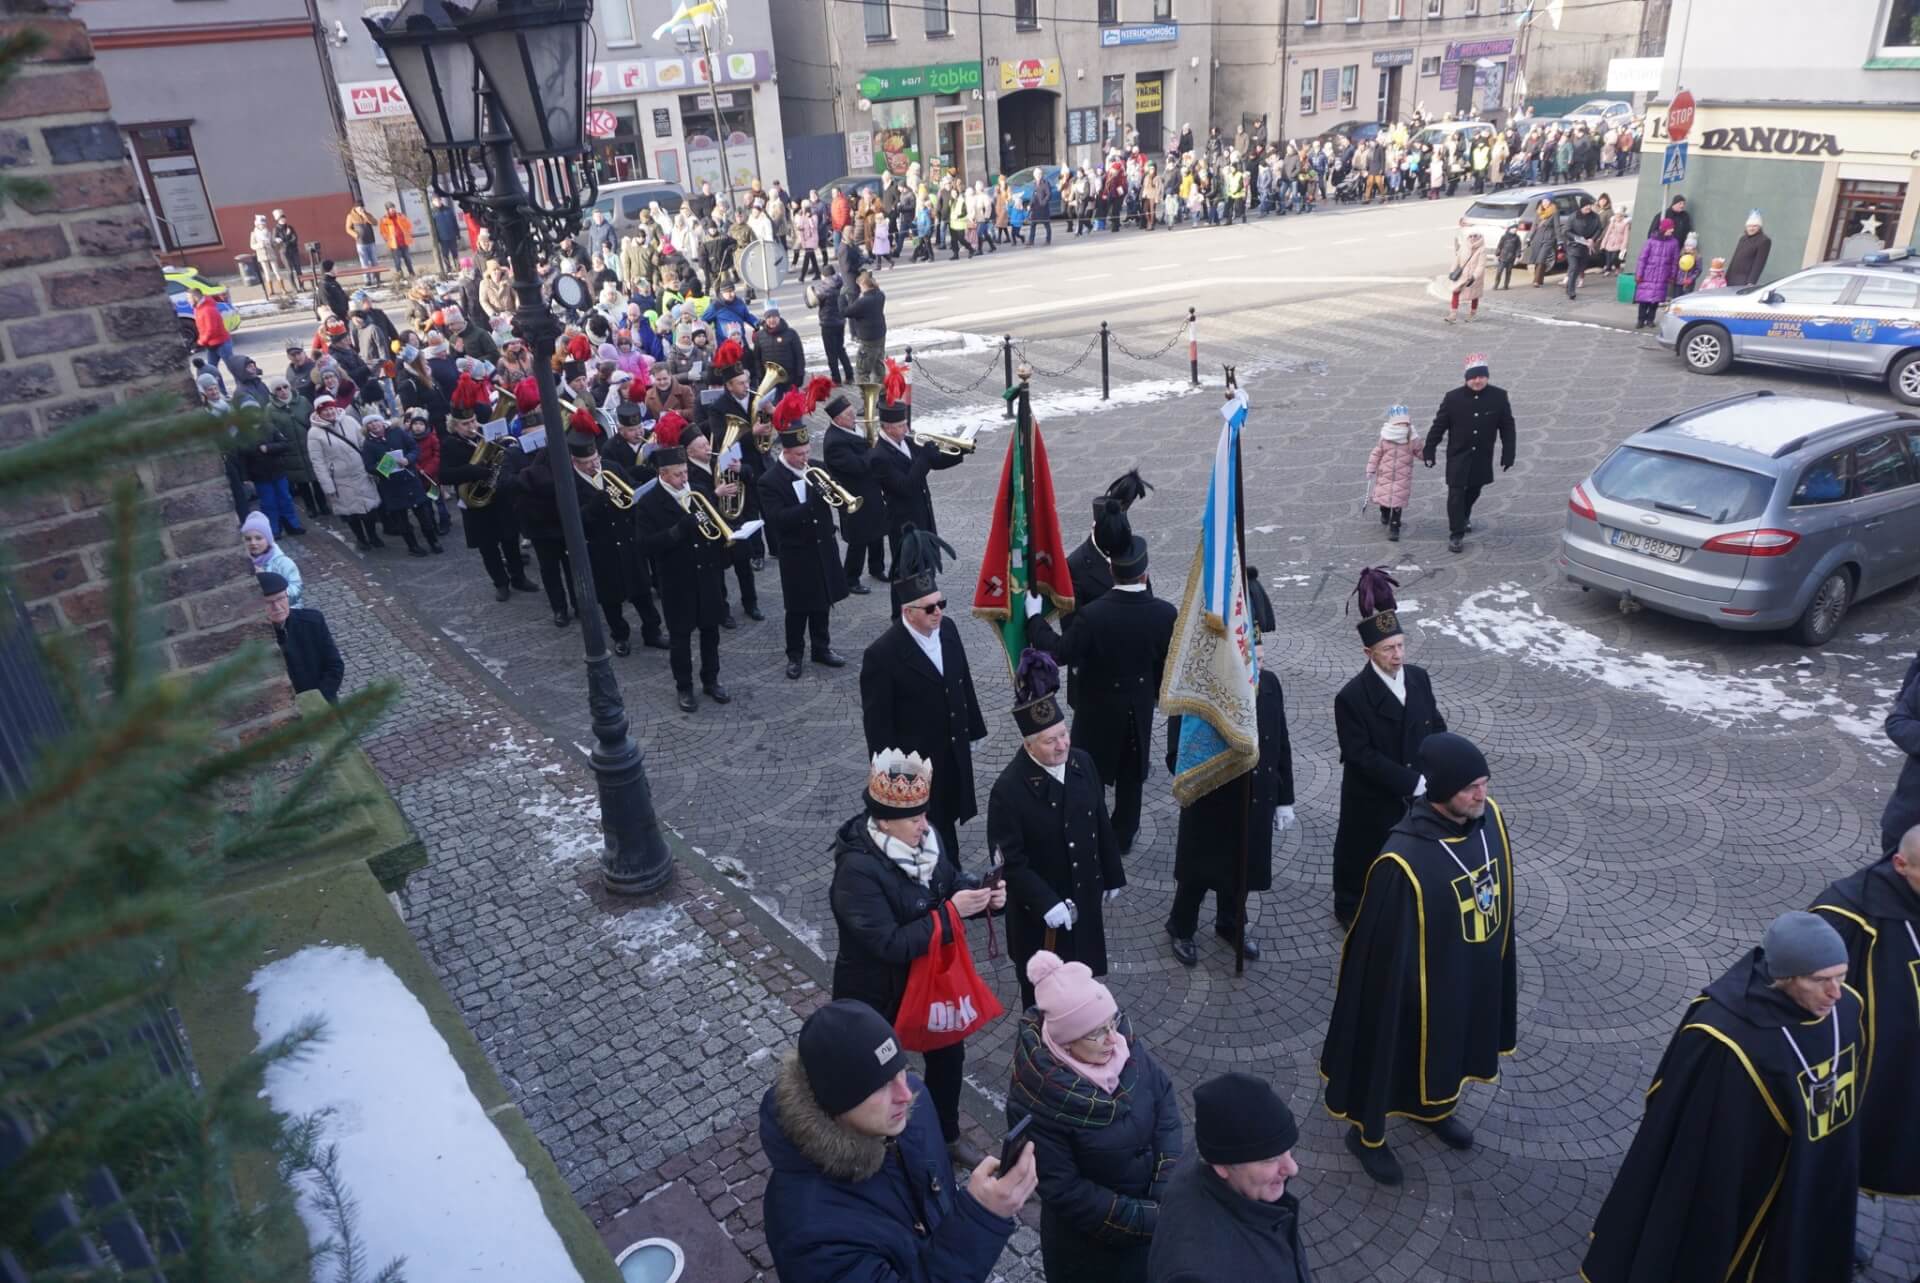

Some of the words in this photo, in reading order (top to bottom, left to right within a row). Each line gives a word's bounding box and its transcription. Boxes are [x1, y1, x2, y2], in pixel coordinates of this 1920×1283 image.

[929, 67, 978, 88] żabka
[1670, 108, 1693, 125] STOP
[1700, 126, 1844, 156] DANUTA
